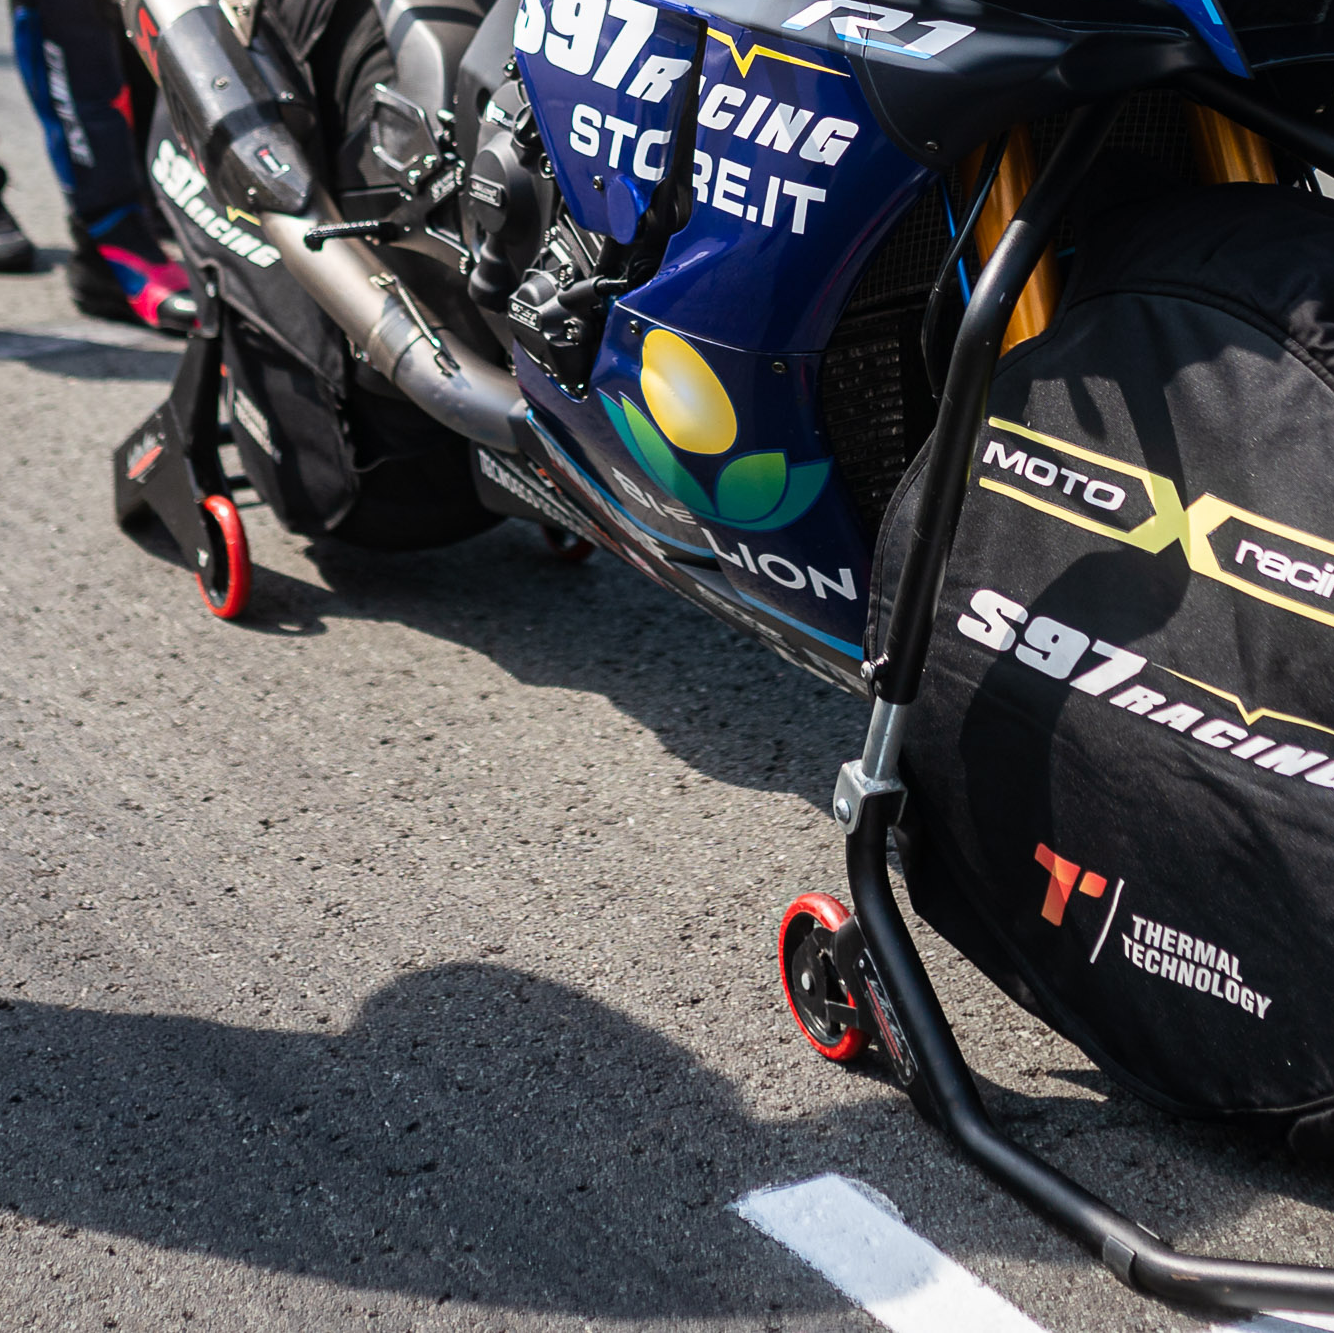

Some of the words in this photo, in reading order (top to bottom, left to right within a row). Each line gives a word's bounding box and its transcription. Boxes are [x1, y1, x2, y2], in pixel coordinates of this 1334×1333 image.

[982, 440, 1127, 512] MOTO
[1120, 932, 1273, 1020] TECHNOLOGY
[1131, 913, 1243, 983] THERMAL
